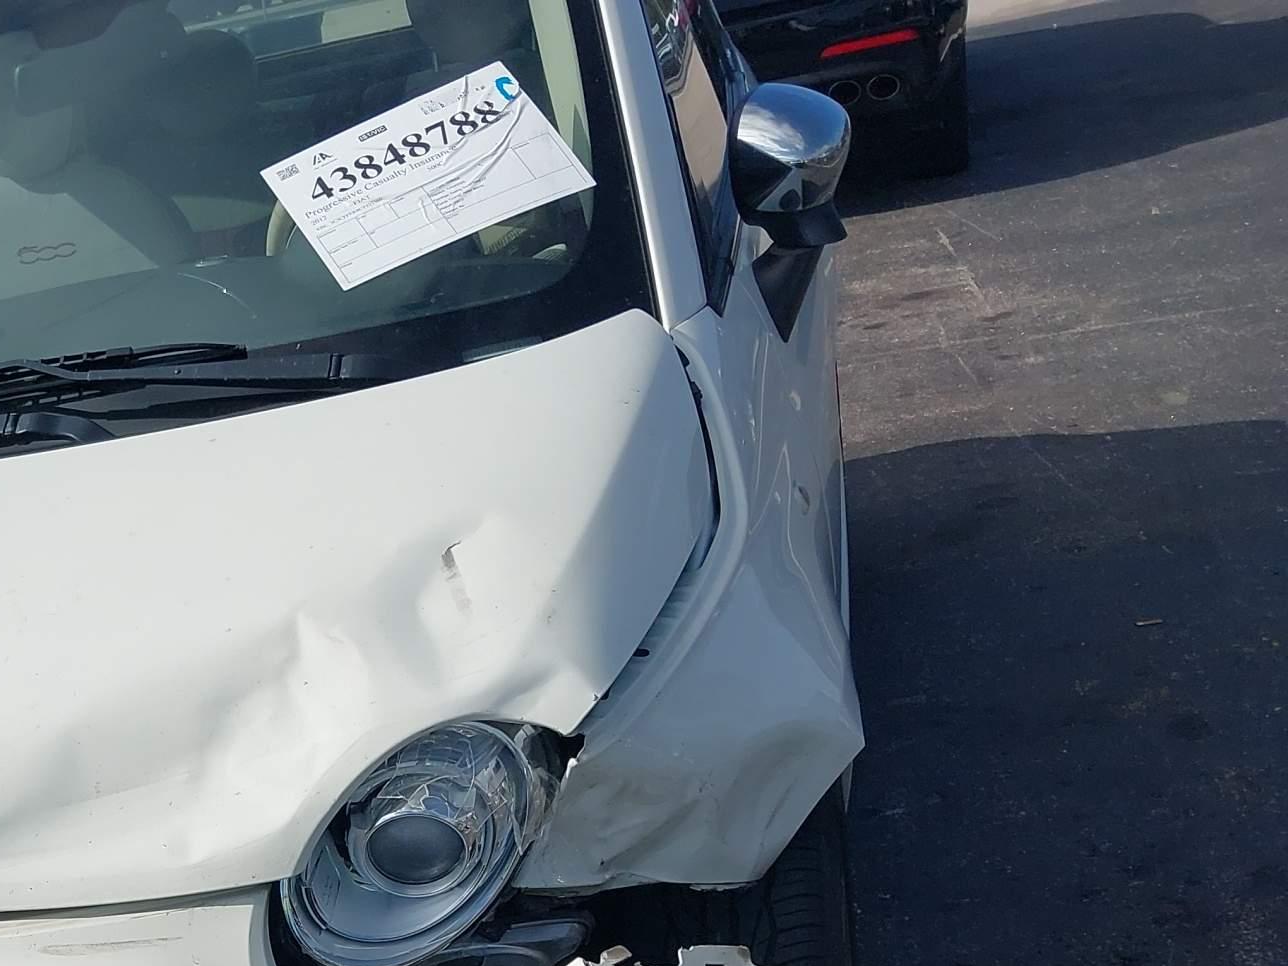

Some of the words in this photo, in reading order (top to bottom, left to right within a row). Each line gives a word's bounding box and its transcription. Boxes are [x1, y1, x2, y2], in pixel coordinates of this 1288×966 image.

[304, 189, 363, 219] Progressive
[364, 166, 407, 191] Casualty
[408, 145, 457, 170] Insurance
[311, 101, 501, 201] 43848788
[17, 242, 77, 264] 500
